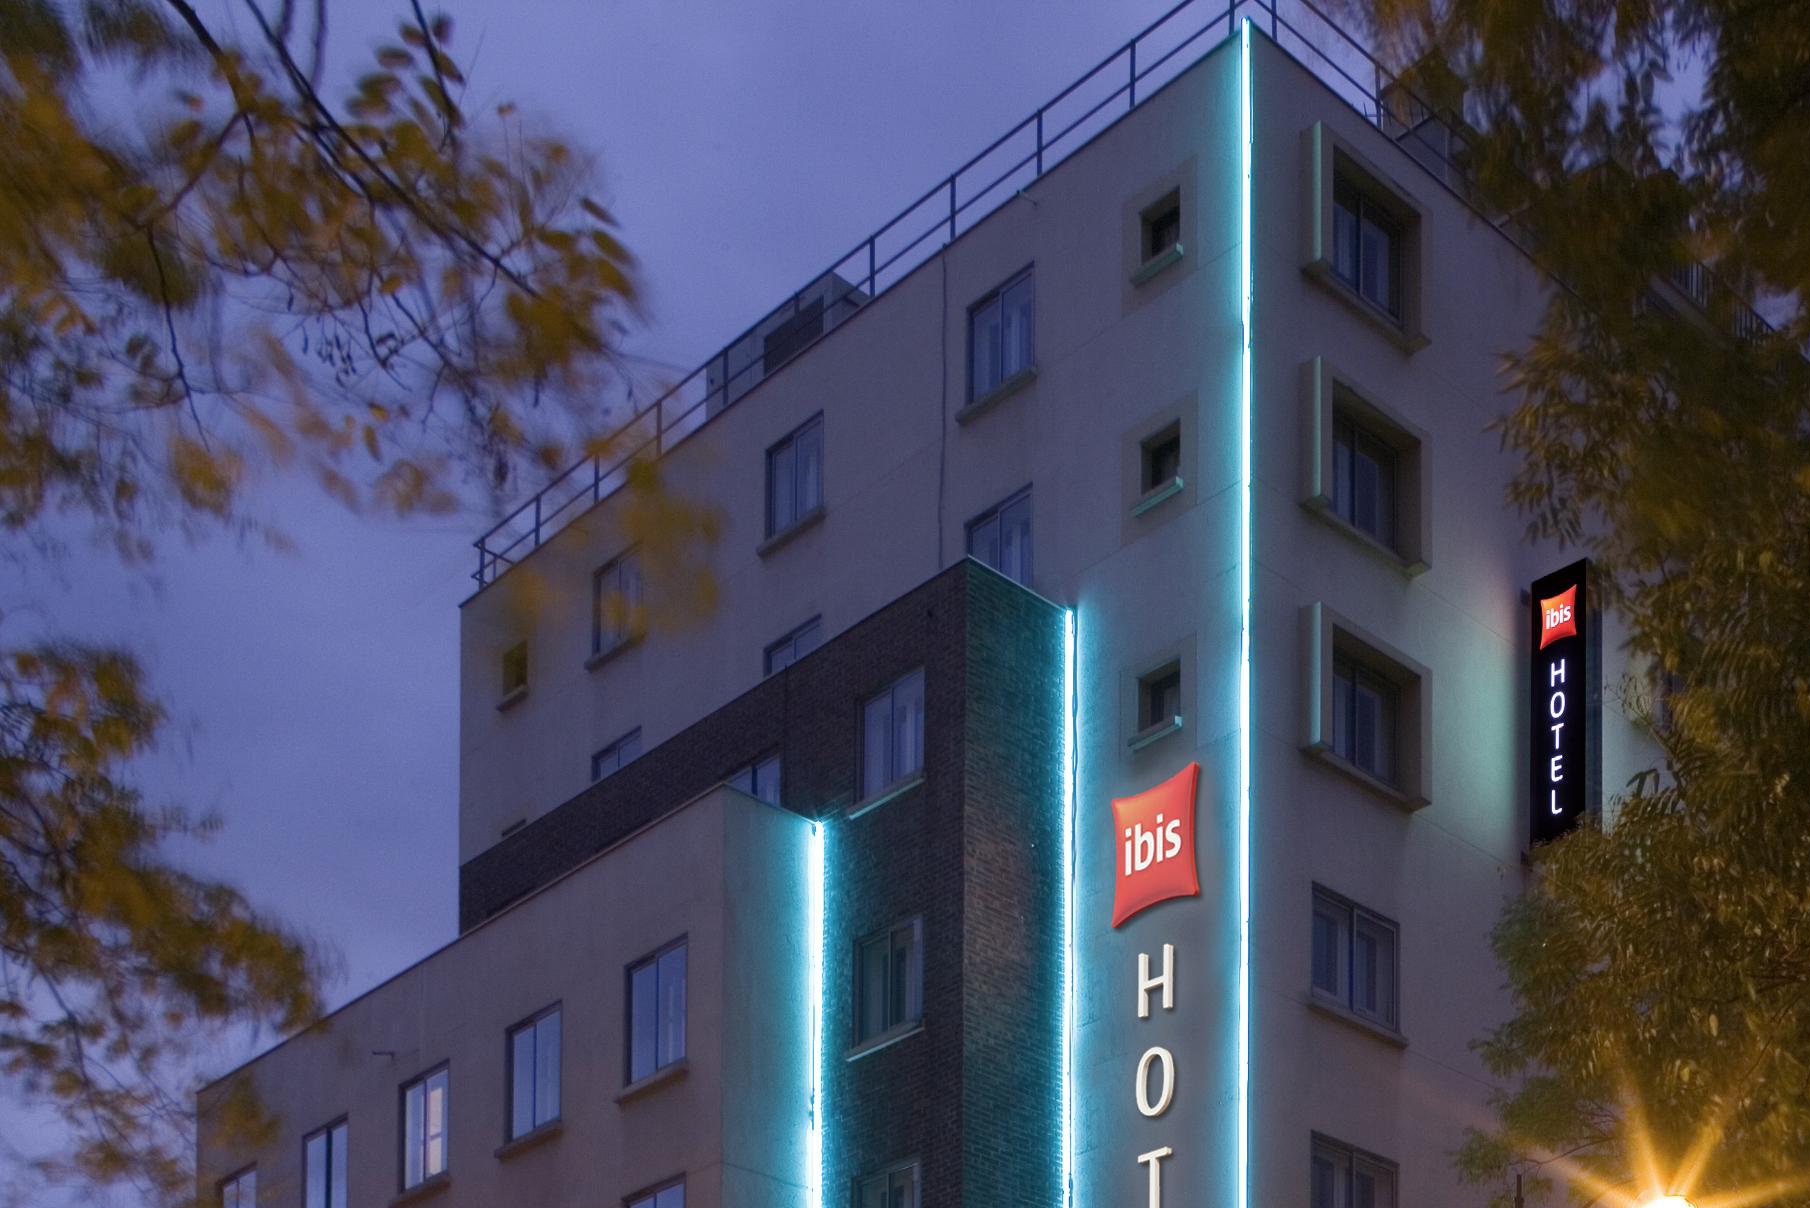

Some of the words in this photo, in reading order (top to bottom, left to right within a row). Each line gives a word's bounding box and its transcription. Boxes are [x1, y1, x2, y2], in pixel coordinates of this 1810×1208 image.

[1545, 604, 1572, 630] ibis
[1550, 658, 1566, 815] HOTEL
[1124, 813, 1182, 876] ibis
